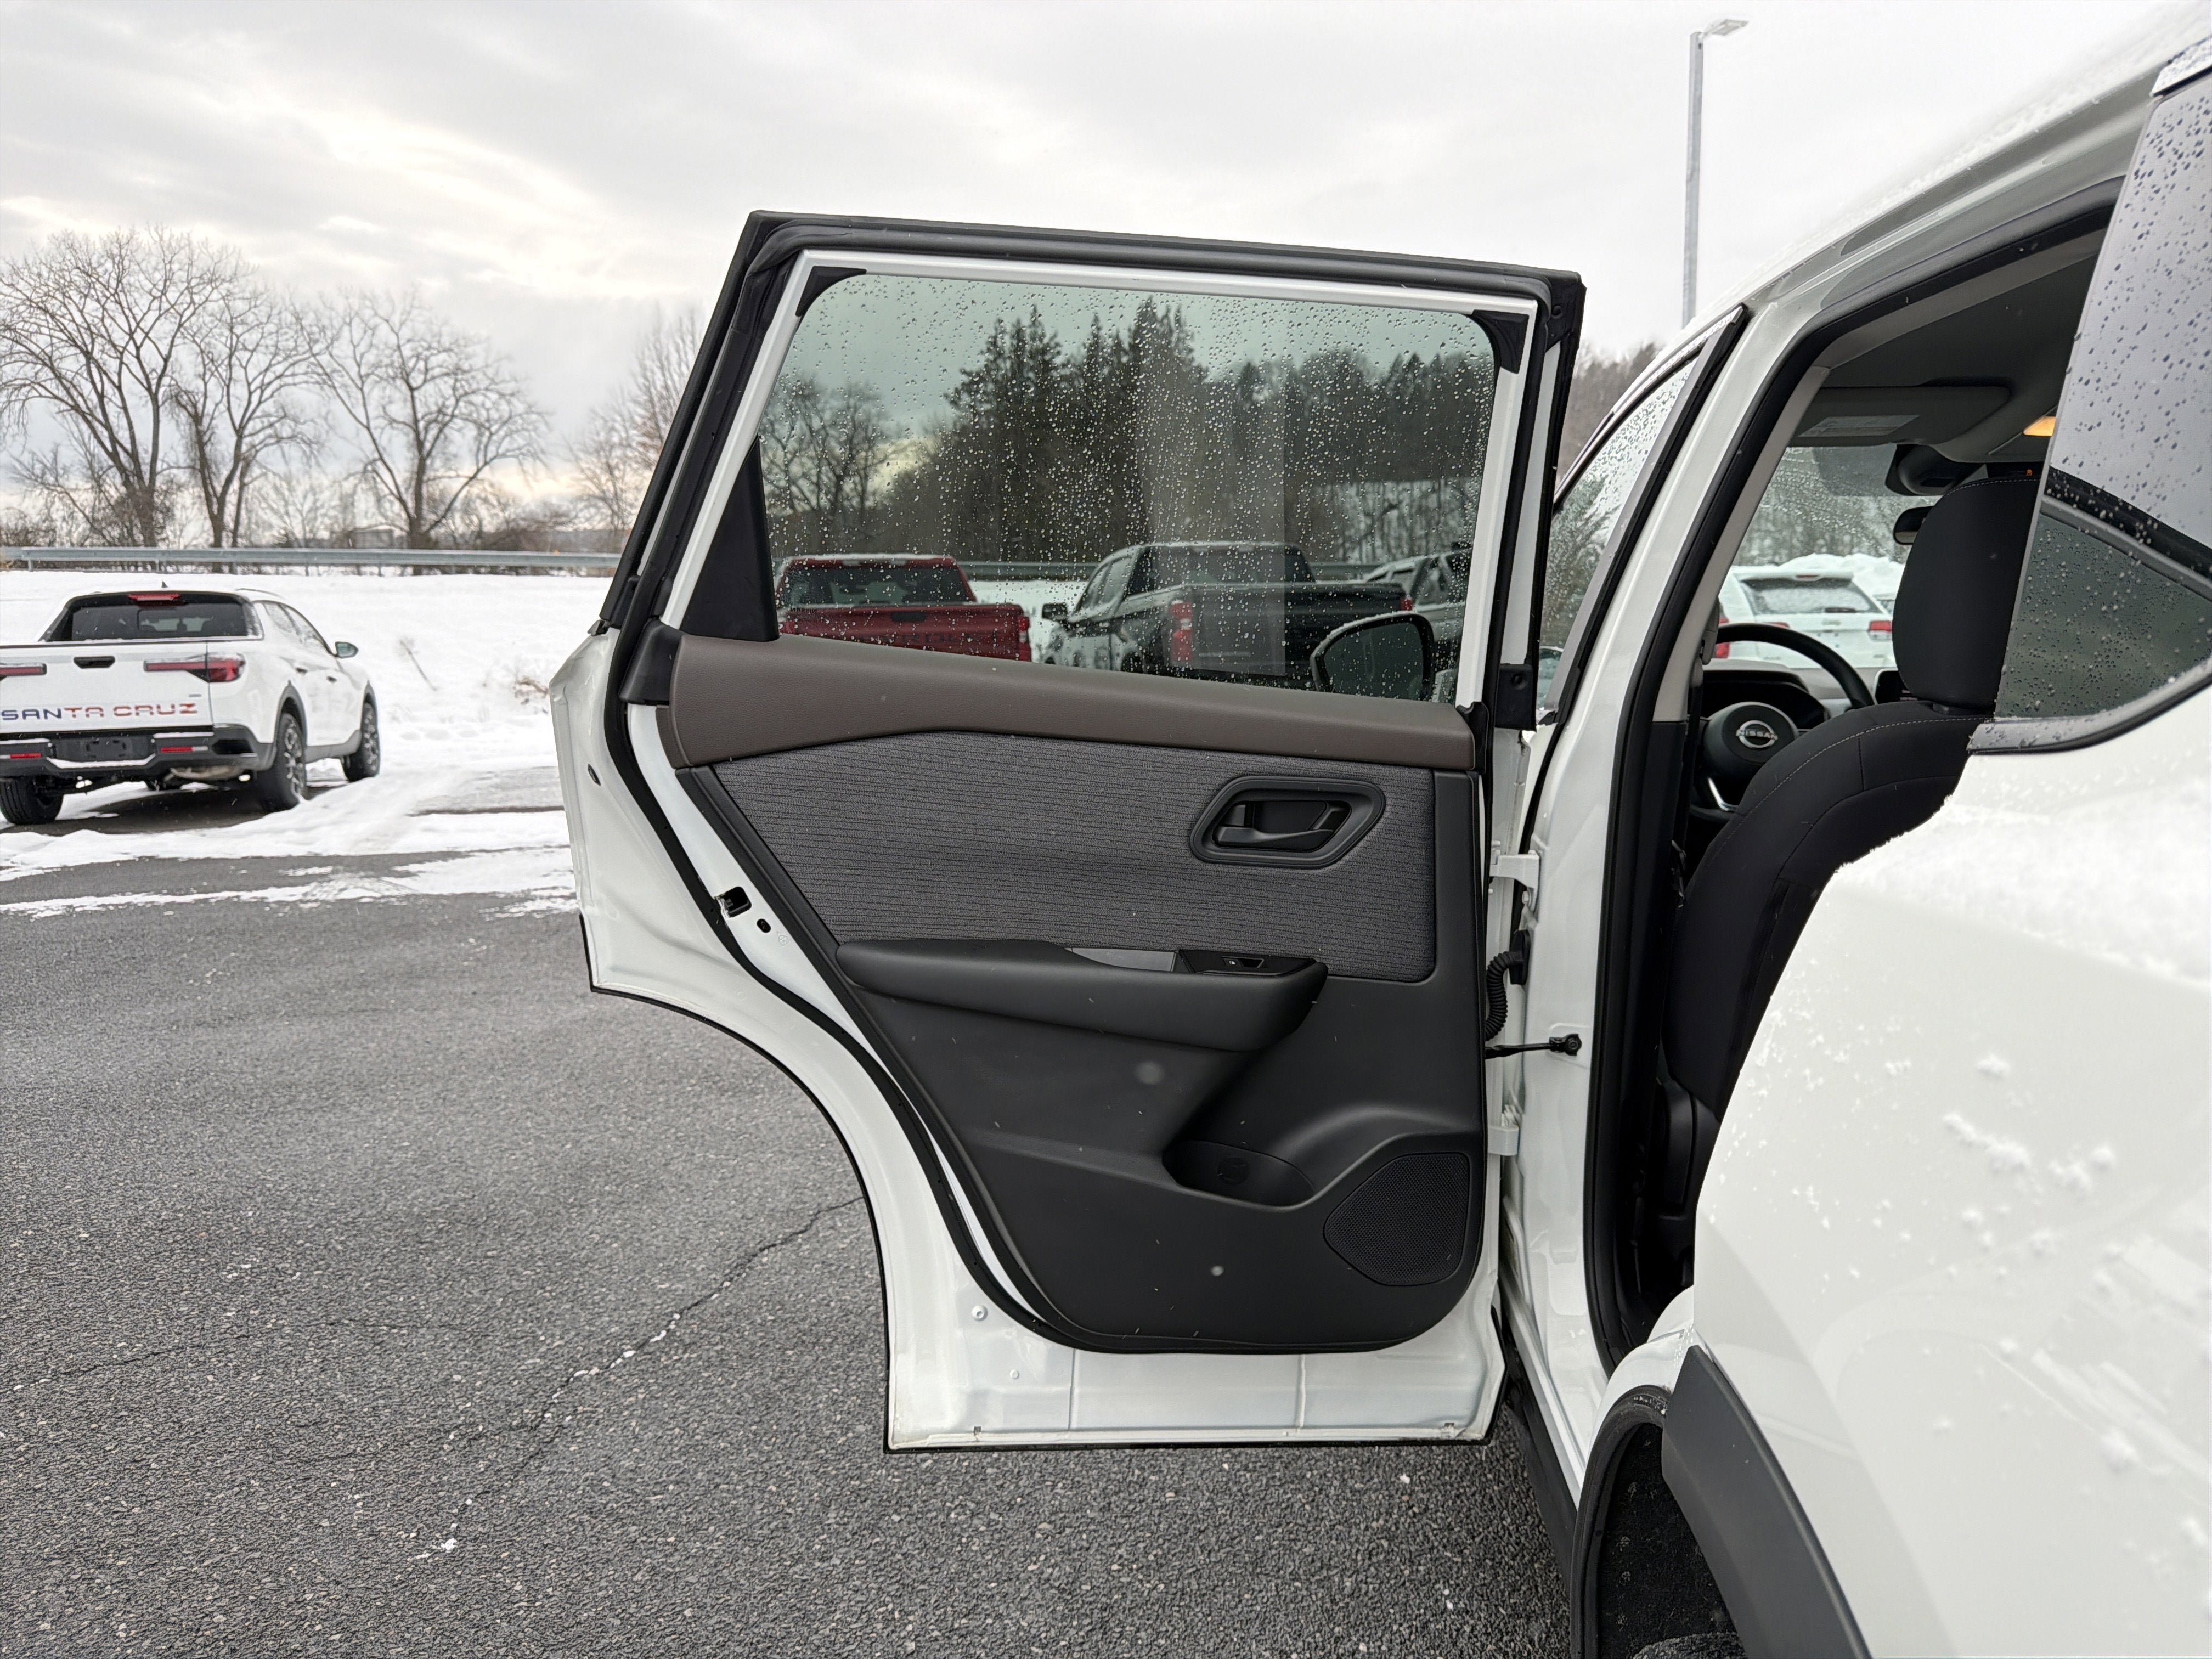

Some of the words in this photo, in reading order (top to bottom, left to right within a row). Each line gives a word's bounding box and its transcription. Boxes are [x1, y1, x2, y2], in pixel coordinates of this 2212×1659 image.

[1, 707, 104, 721] SANTA
[113, 703, 199, 716] CRUZ
[1735, 729, 1778, 740] NISSAN
